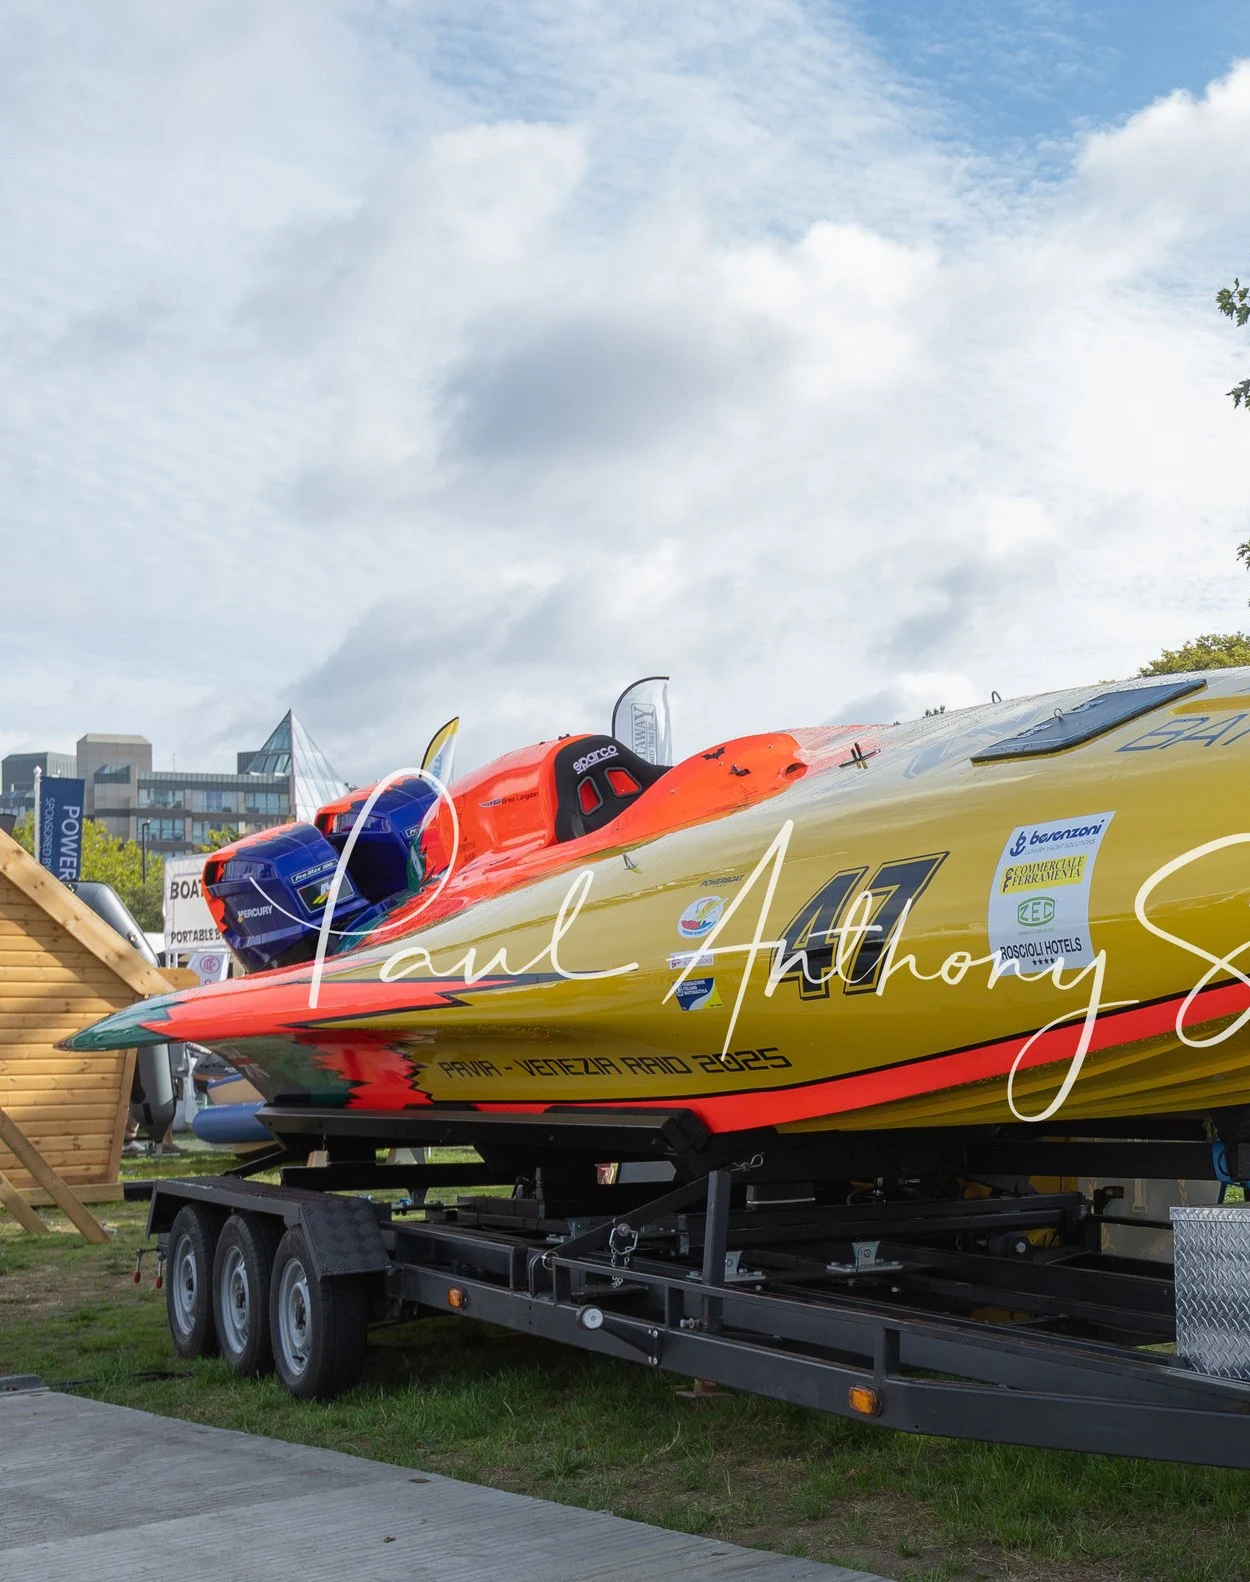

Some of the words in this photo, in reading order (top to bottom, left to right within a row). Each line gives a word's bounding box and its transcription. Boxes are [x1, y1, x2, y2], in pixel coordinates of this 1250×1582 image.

[634, 706, 654, 758] TAWAY
[573, 745, 618, 774] sparco
[42, 797, 55, 856] SPONSORED
[59, 805, 81, 880] POWER
[308, 867, 321, 876] Max
[1012, 867, 1081, 887] FERRAMENTA
[1013, 855, 1084, 876] COMMERCIALE
[237, 905, 273, 919] MERCURY
[171, 928, 213, 944] PORTABLE
[769, 851, 951, 1001] 47
[1000, 941, 1043, 960] ROSCIOLI
[1044, 937, 1083, 955] HOTELS
[519, 1056, 621, 1077] VENEZIA
[618, 1055, 693, 1075] RAID
[692, 1047, 793, 1073] 2025
